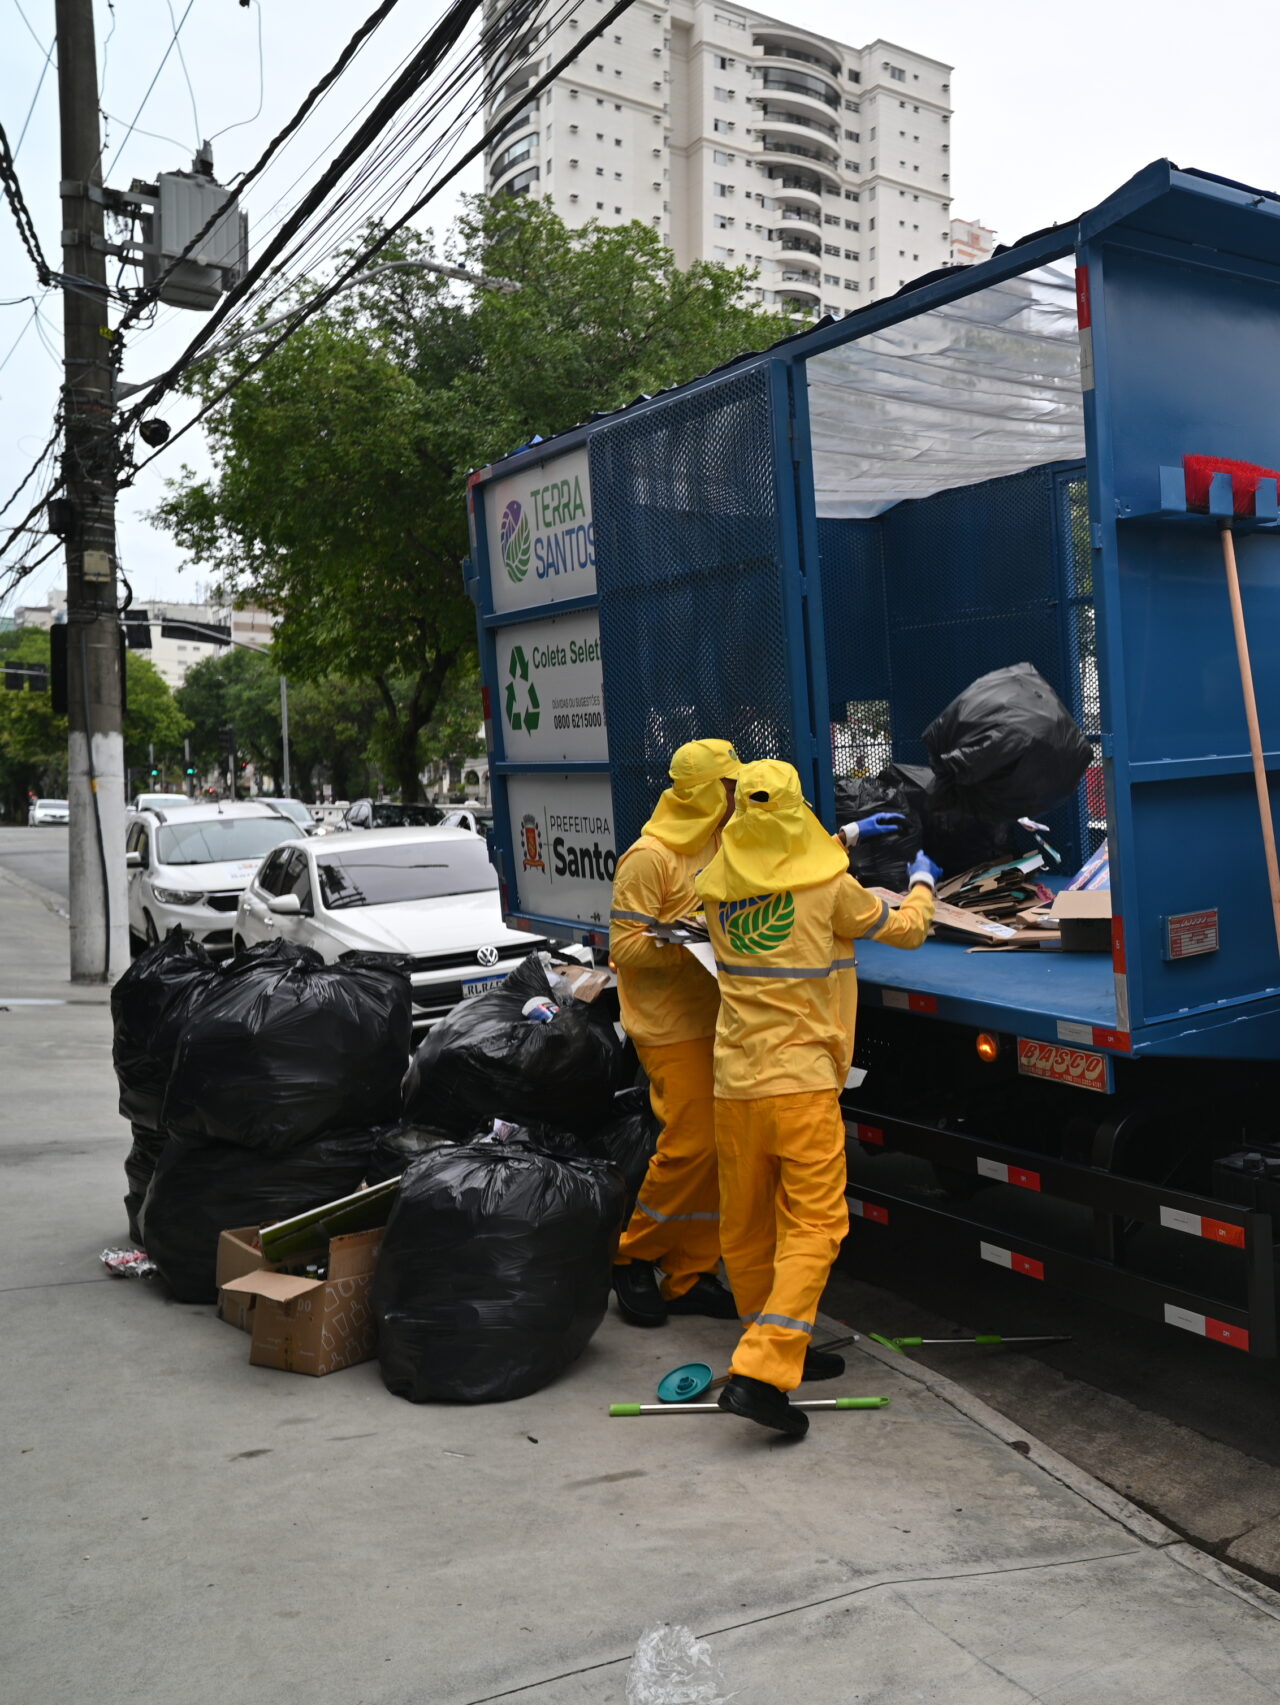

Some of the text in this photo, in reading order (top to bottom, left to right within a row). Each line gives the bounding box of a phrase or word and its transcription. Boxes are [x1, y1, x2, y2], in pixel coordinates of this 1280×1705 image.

[530, 475, 586, 531] TERRA
[534, 522, 597, 579] SANTOS
[533, 638, 601, 669] Coleta Selet
[554, 711, 602, 730] 0800 6215000
[550, 815, 610, 834] PREFEITURA
[1021, 1042, 1103, 1081] BASCO
